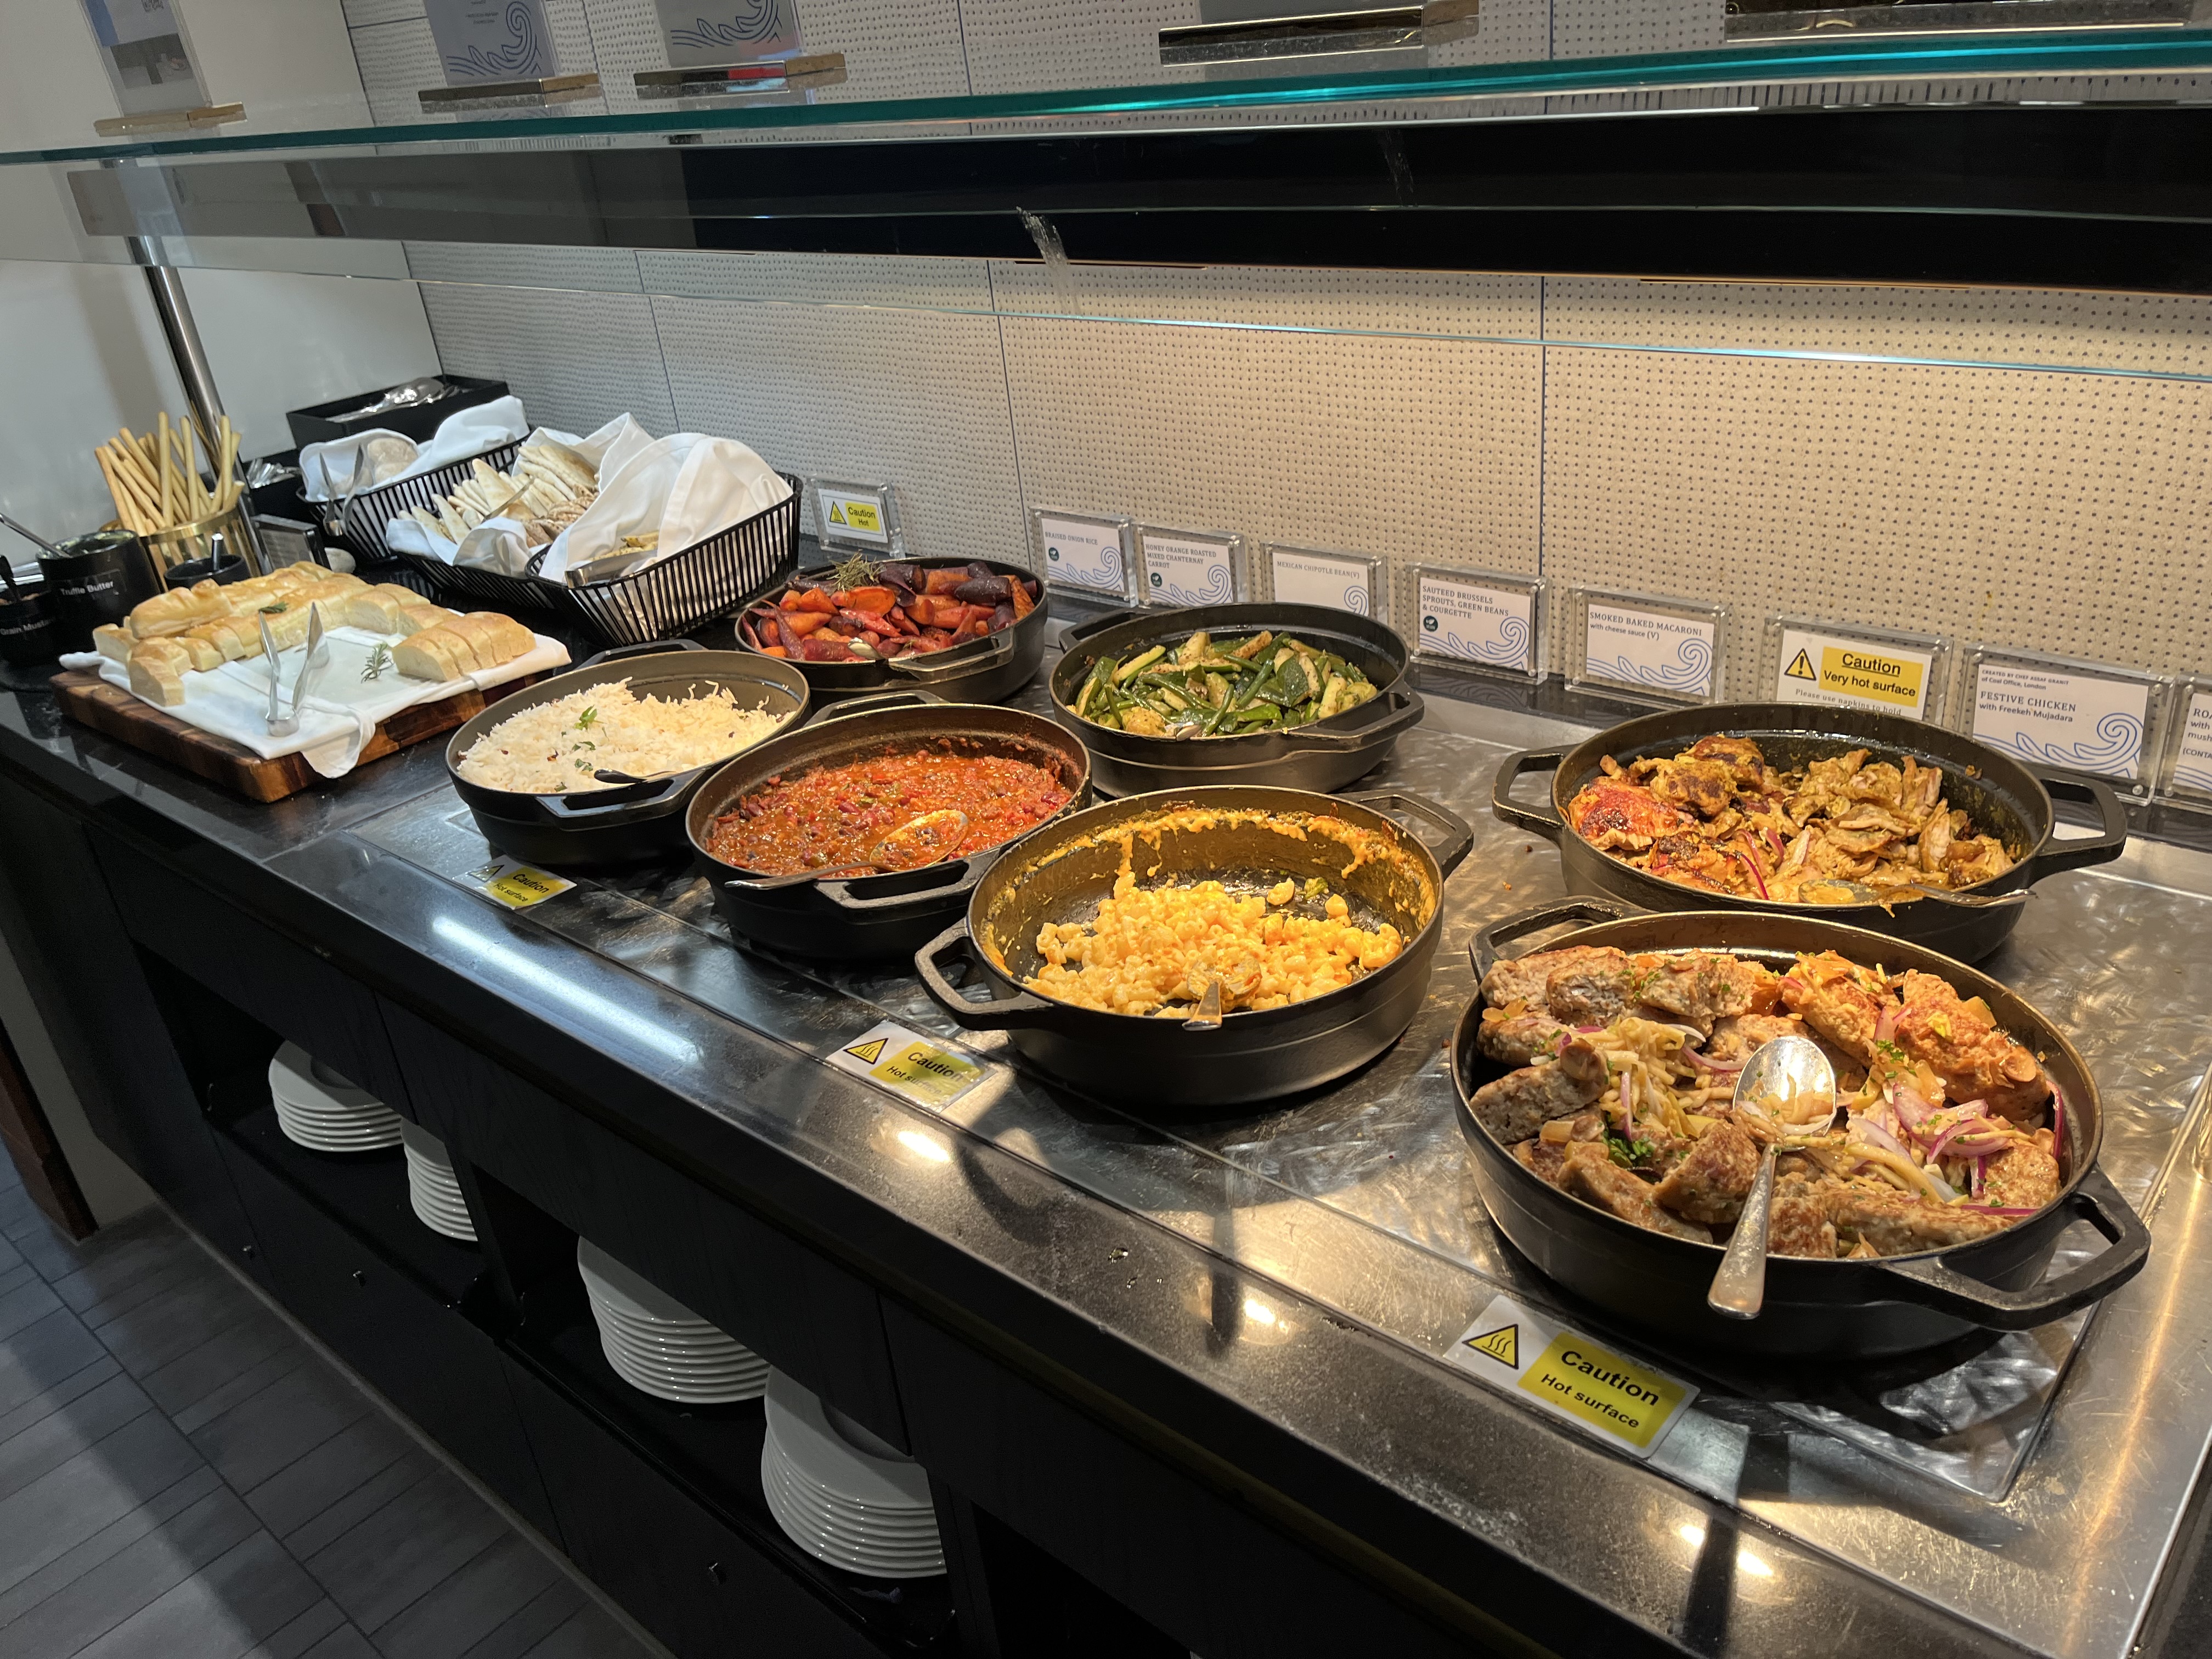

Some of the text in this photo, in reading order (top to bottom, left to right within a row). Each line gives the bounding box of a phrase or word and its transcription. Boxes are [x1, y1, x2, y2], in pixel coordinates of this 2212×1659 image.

[848, 507, 876, 519] Caution
[1045, 532, 1066, 540] BRAISED
[1068, 535, 1084, 543] ONION
[1166, 555, 1203, 565] CHANTERNAY
[1190, 549, 1216, 557] ROASTED
[1277, 561, 1302, 569] MEXICAN
[1304, 565, 1333, 574] CHIPOTLE
[60, 580, 113, 595] Truffle Butter
[1423, 586, 1493, 603] SAUTEED BRUSSELS
[1430, 605, 1472, 619] COURGETTE
[1458, 601, 1482, 611] GREEN
[1485, 606, 1509, 616] BEANS
[1590, 612, 1702, 636] SMOKED BAKED MACARONI
[1647, 631, 1660, 641] (V)
[1842, 653, 1900, 675] Caution
[1824, 670, 1916, 697] Very hot surface
[1796, 689, 1820, 699] Please
[1838, 698, 1870, 710] napkins
[1883, 706, 1901, 715] hold
[1981, 691, 2076, 712] FESTIVE CHICKEN
[1999, 705, 2031, 716] Freekeh
[2034, 710, 2073, 722] Mujadara
[2191, 721, 2210, 730] with
[513, 874, 549, 893] Caution
[494, 883, 528, 902] Hot surface
[887, 1066, 908, 1079] Hot
[908, 1052, 963, 1082] Caution
[1561, 1351, 1659, 1406] Caution
[1541, 1374, 1639, 1427] Hot surface
